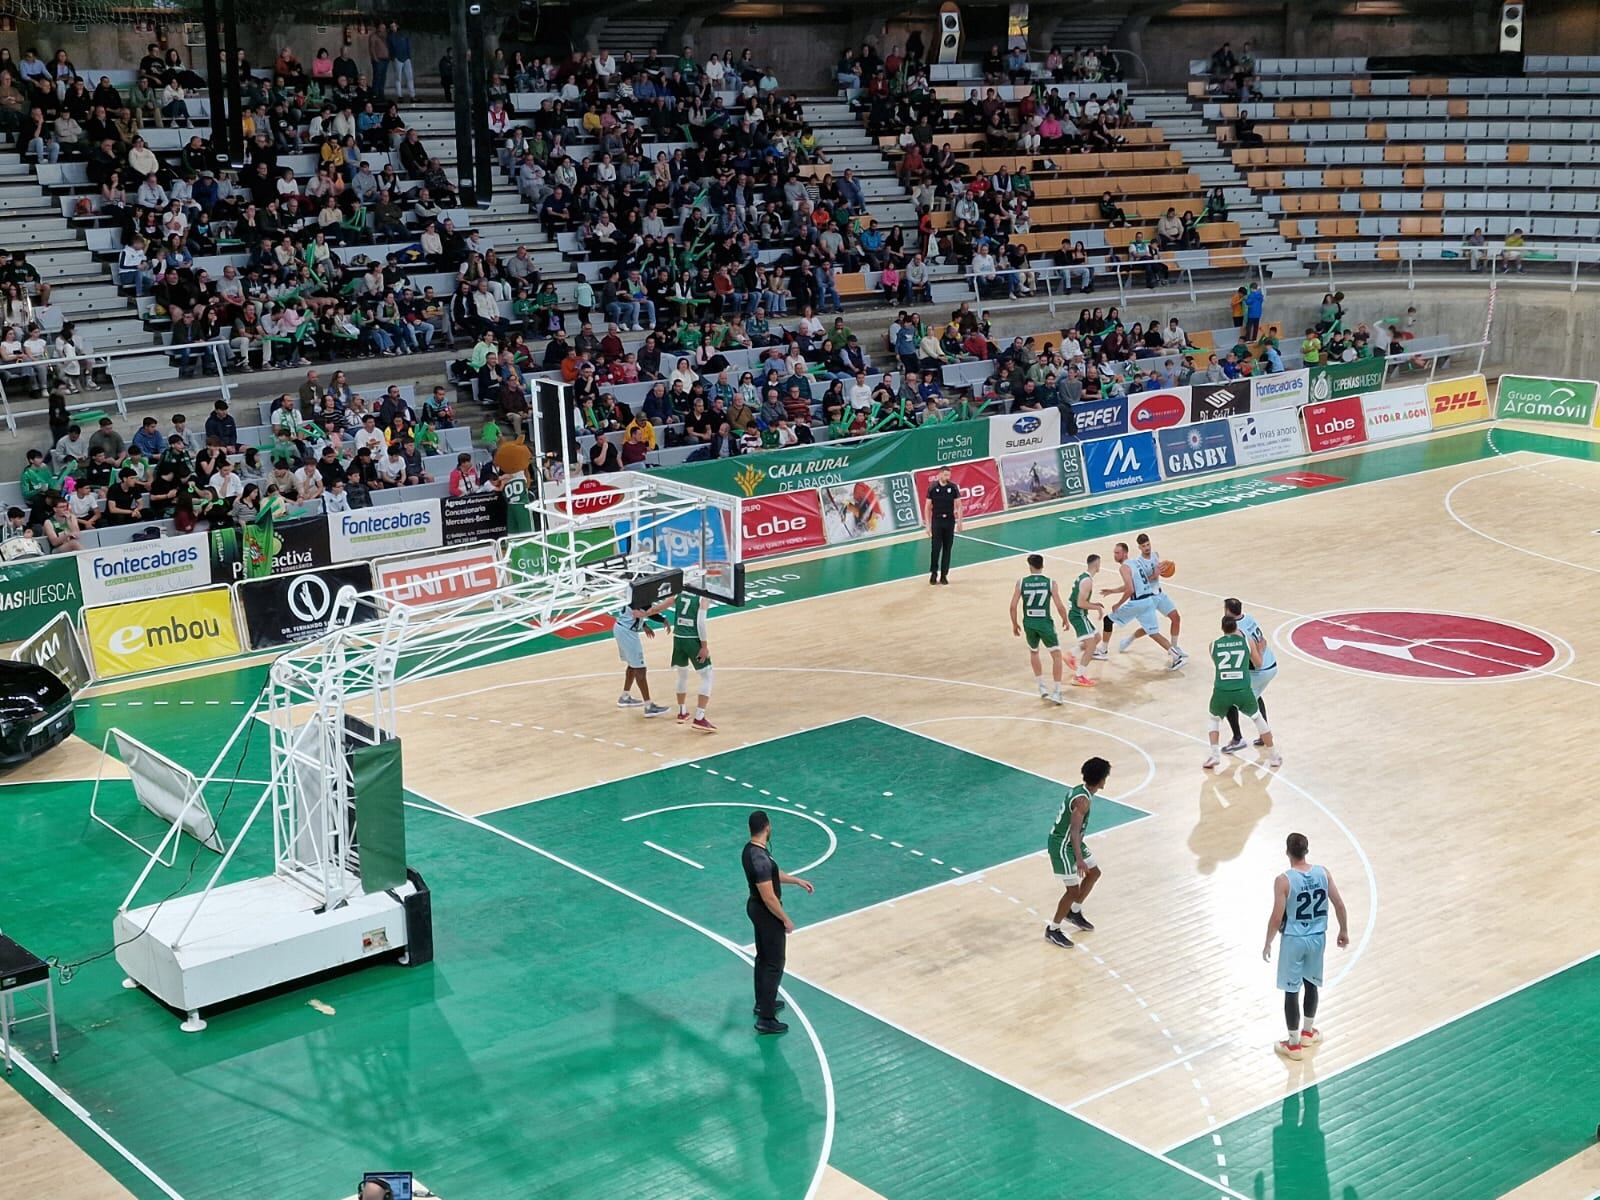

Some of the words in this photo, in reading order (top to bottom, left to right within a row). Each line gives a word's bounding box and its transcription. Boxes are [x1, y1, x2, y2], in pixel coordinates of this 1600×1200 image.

[1434, 391, 1482, 413] DHL
[1508, 391, 1541, 400] Grupo
[1073, 405, 1121, 429] ERFEY
[1504, 400, 1587, 418] Aramóvil
[1315, 418, 1355, 435] Lobe
[955, 435, 973, 447] San
[1005, 437, 1043, 448] SUBARU
[937, 448, 973, 461] Lorenzo
[1168, 445, 1228, 473] GASBY
[768, 463, 802, 479] CAJA
[805, 456, 849, 473] RURAL
[505, 481, 524, 498] 00
[779, 481, 793, 492] DE
[797, 472, 841, 490] ARAGÓN
[1185, 484, 1298, 509] Deportes
[1059, 498, 1174, 523] Patronato
[743, 516, 807, 539] Lobe
[390, 562, 491, 601] UNITIC
[680, 598, 692, 615] 7
[1023, 590, 1048, 606] 77
[108, 616, 220, 655] embou
[1216, 650, 1245, 670] 27
[1295, 888, 1328, 920] 22
